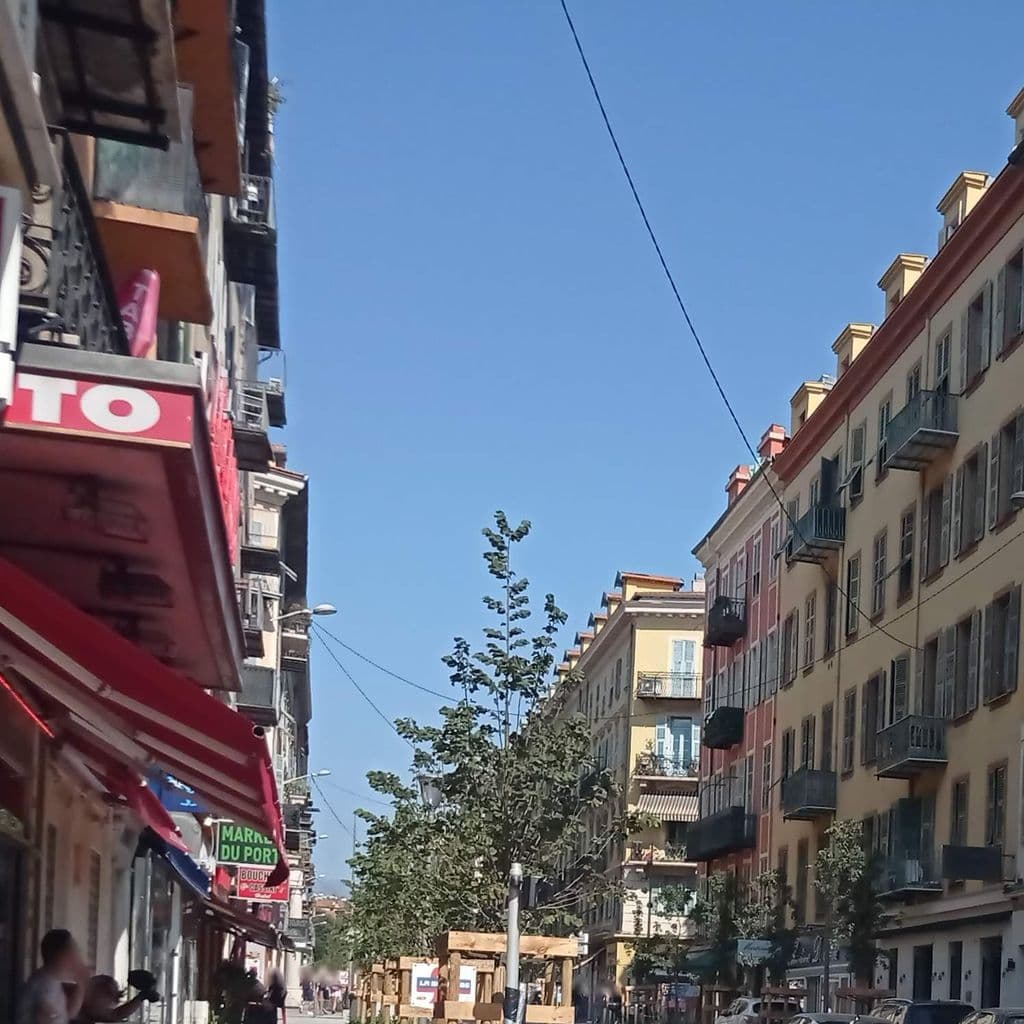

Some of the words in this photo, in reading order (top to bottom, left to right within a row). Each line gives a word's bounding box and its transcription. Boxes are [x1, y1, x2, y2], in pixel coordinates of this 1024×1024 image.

[221, 844, 240, 860] DU
[244, 846, 278, 864] PORT
[241, 868, 271, 881] BOUCH
